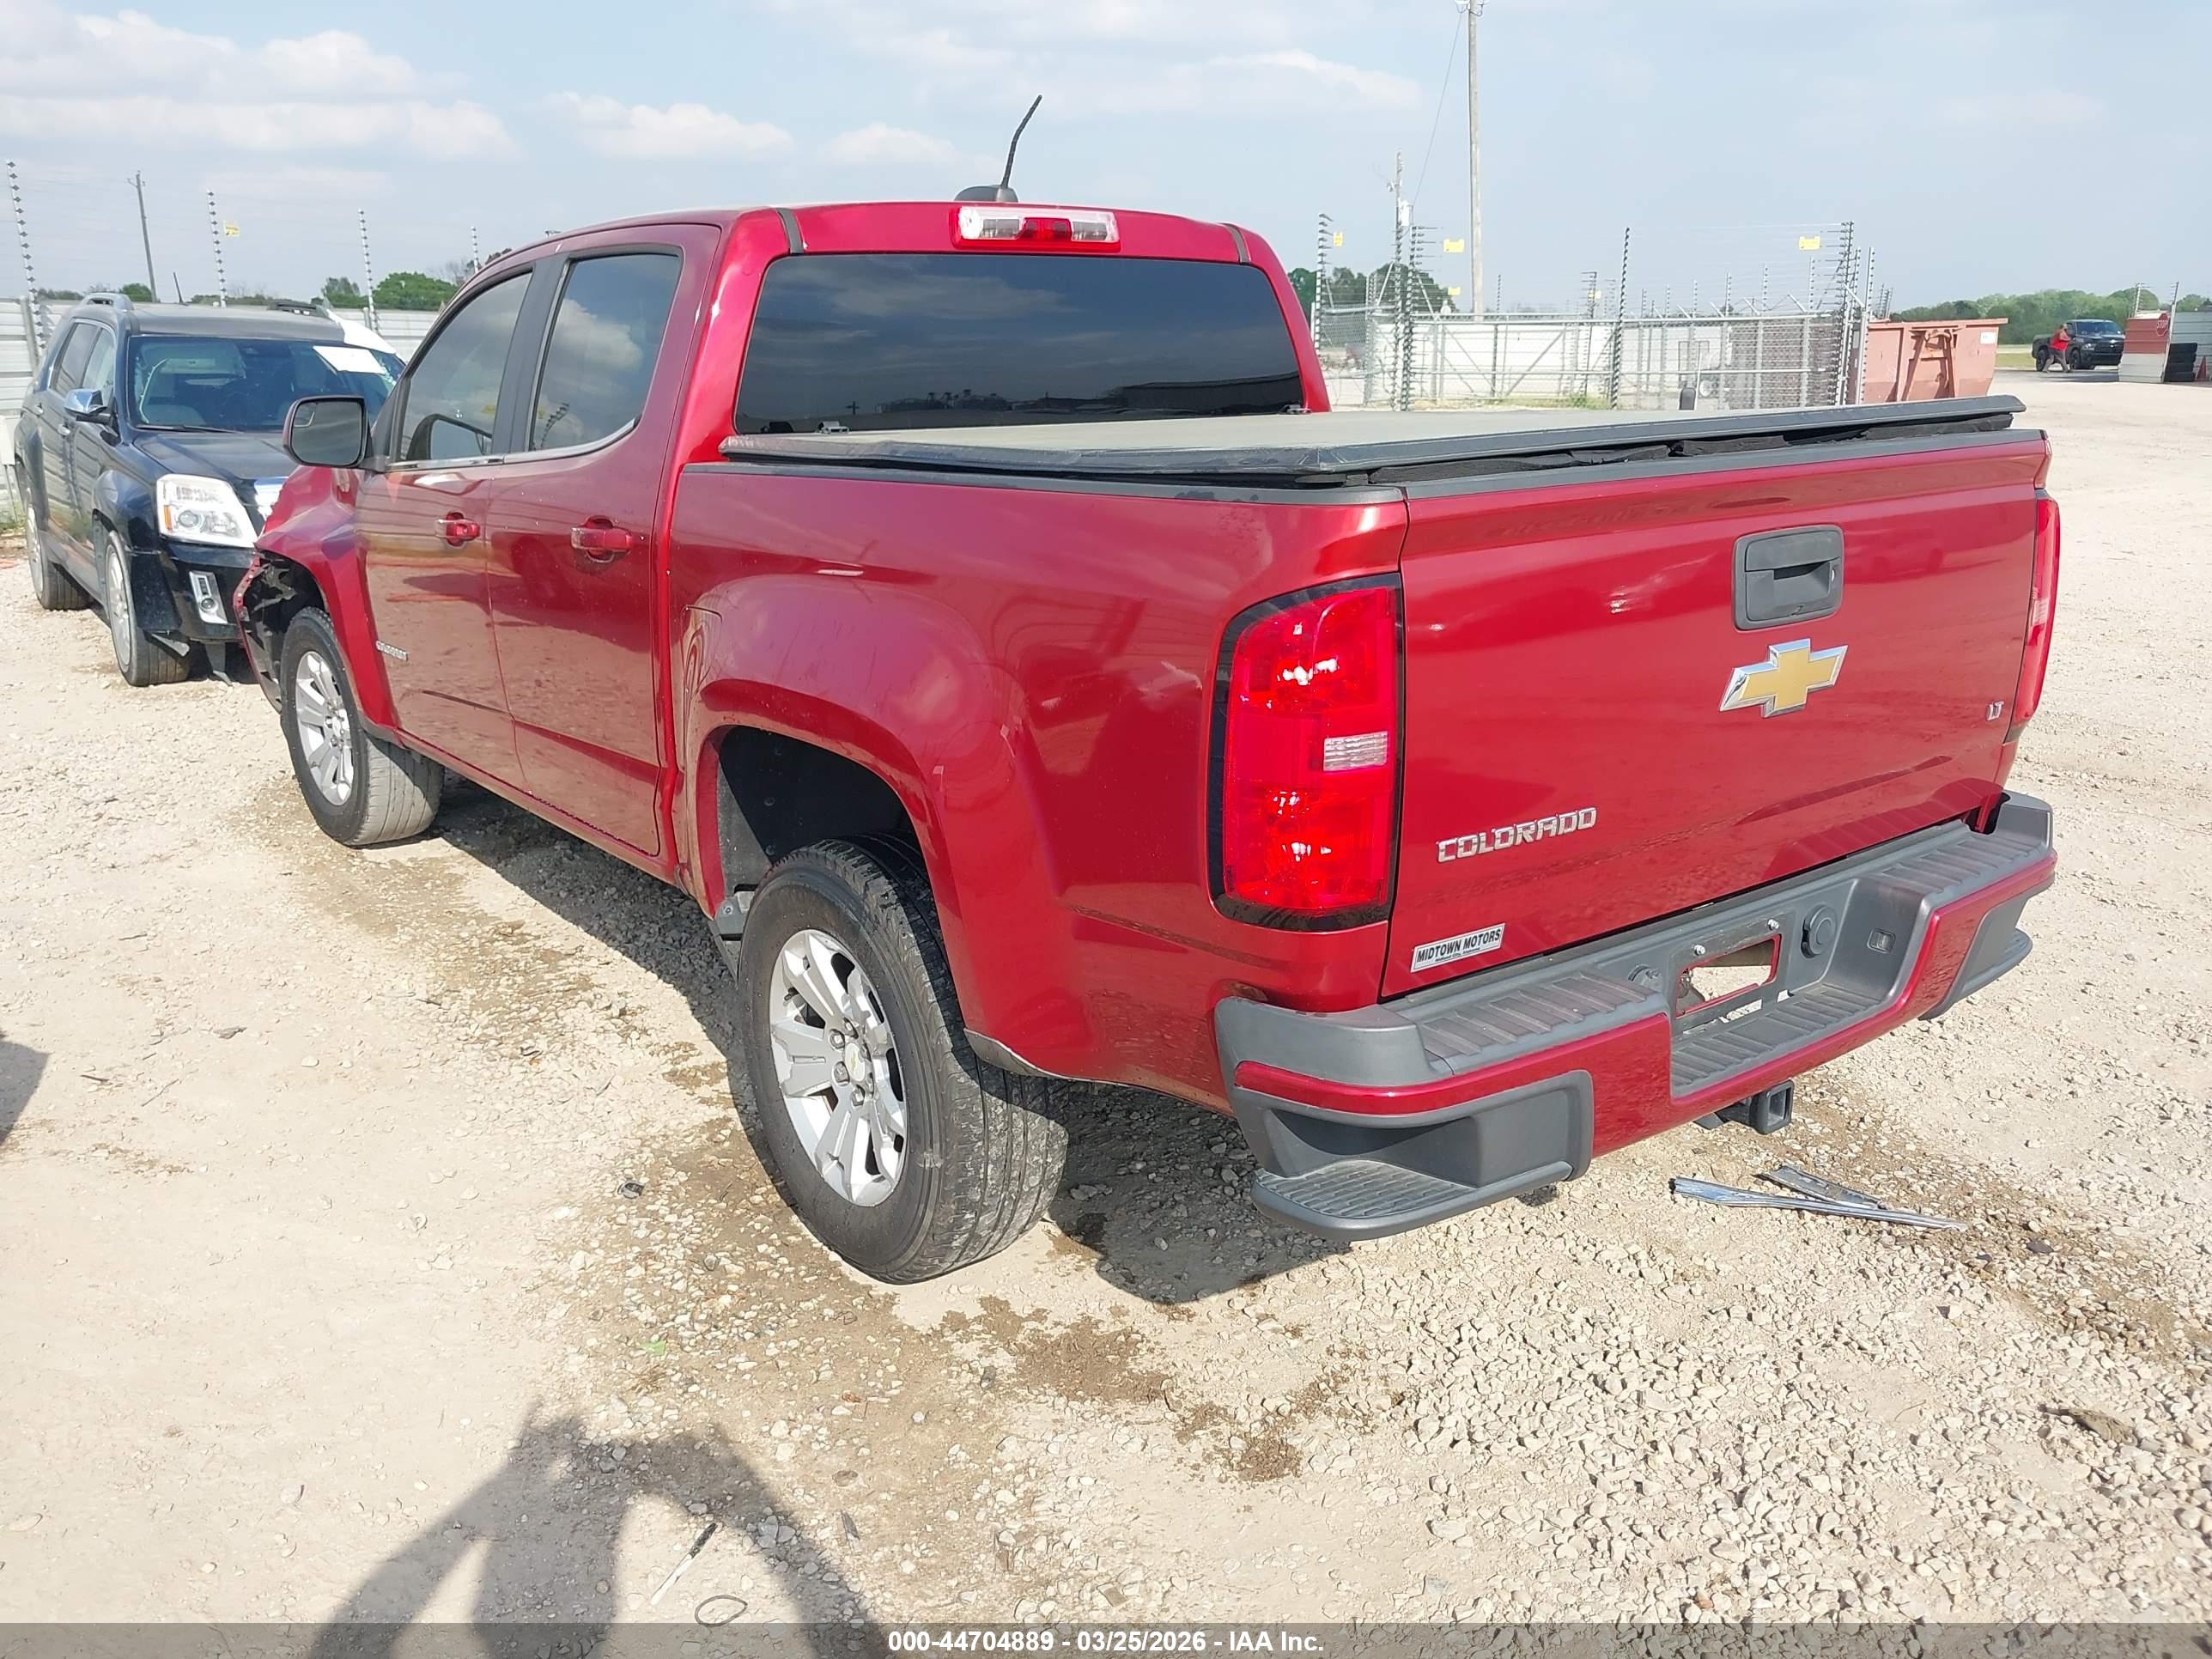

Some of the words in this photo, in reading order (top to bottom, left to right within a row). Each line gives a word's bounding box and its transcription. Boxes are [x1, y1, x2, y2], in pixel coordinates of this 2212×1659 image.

[1986, 701, 2004, 721] LT
[1437, 807, 1597, 863] COLORADO
[1417, 939, 1462, 963] MIDTOWN
[1463, 928, 1501, 951] MOTORS
